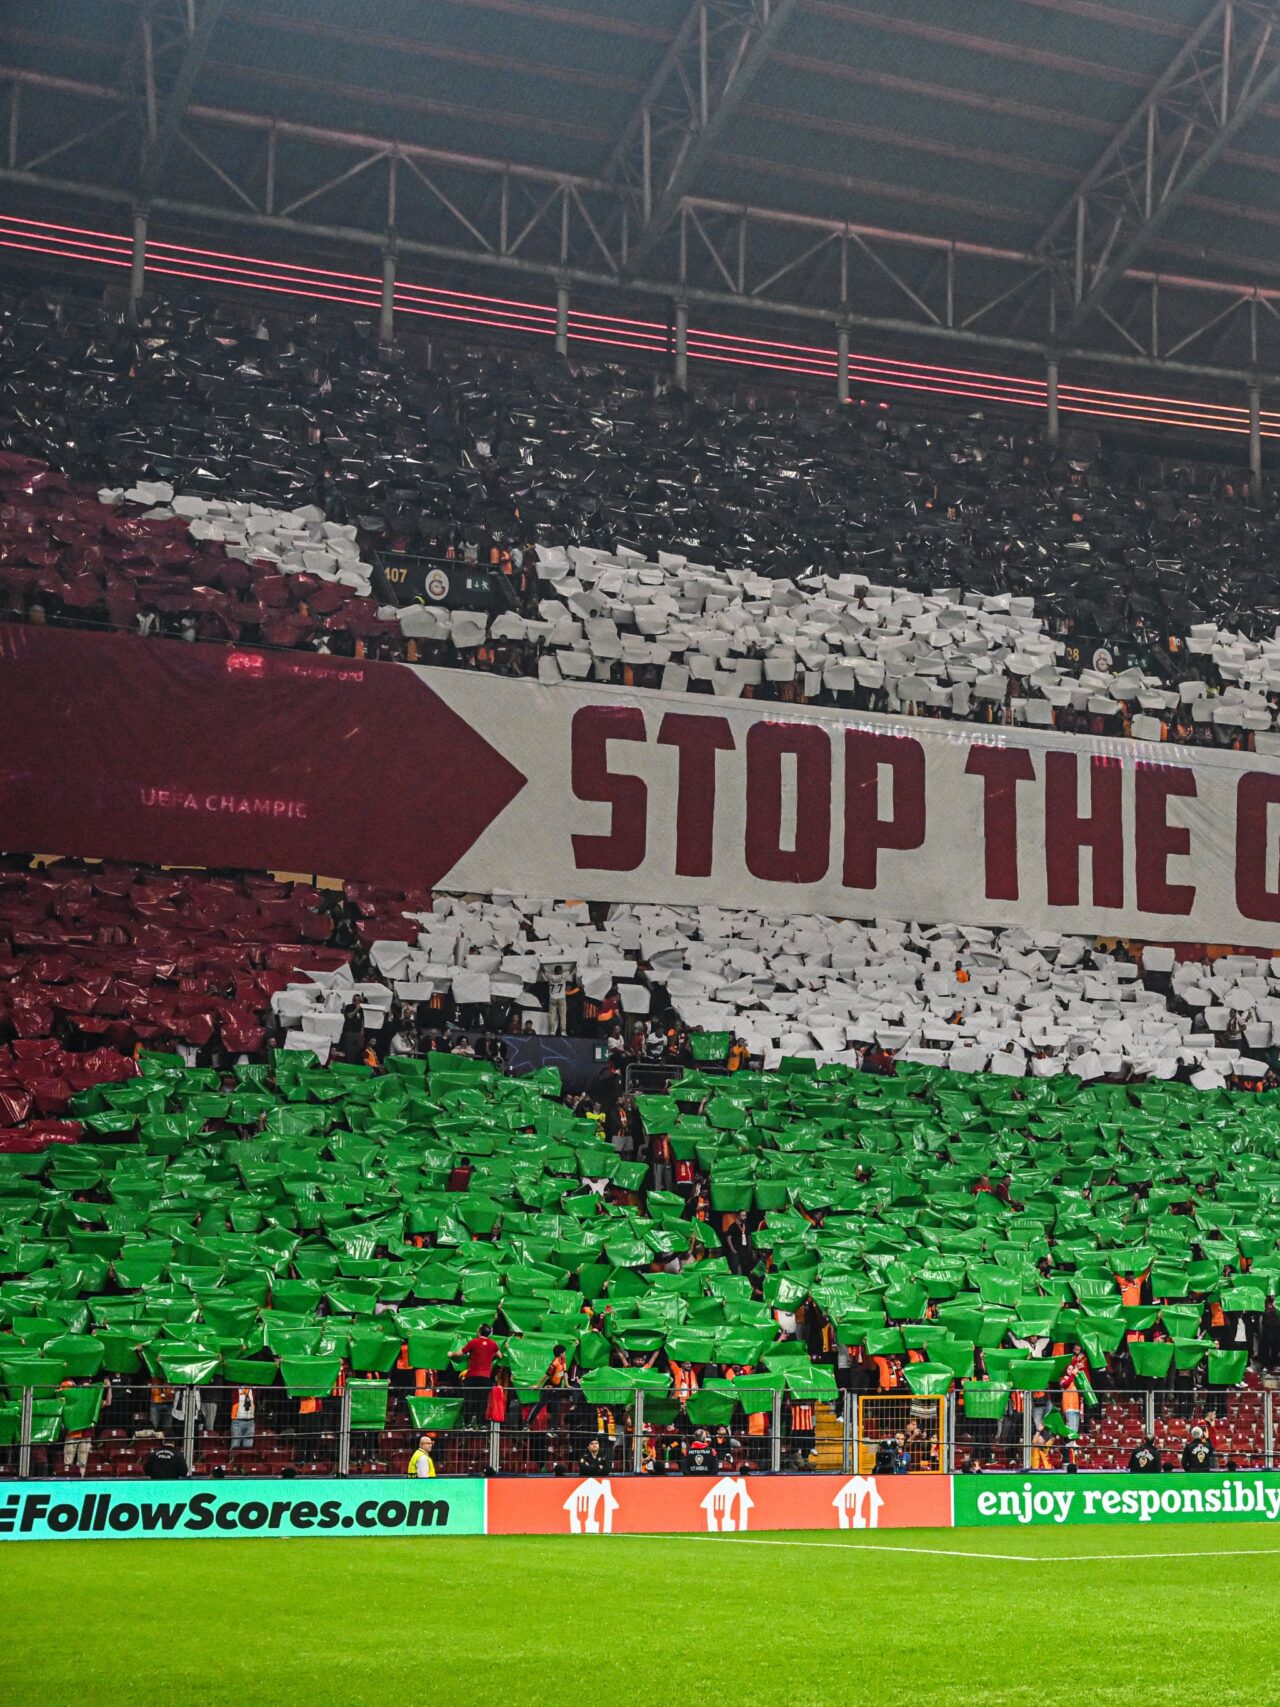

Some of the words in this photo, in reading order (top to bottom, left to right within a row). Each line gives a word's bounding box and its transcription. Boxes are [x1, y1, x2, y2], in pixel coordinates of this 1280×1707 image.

[571, 705, 926, 889] STOP
[965, 743, 1198, 915] THE
[977, 1482, 1075, 1523] enjoy
